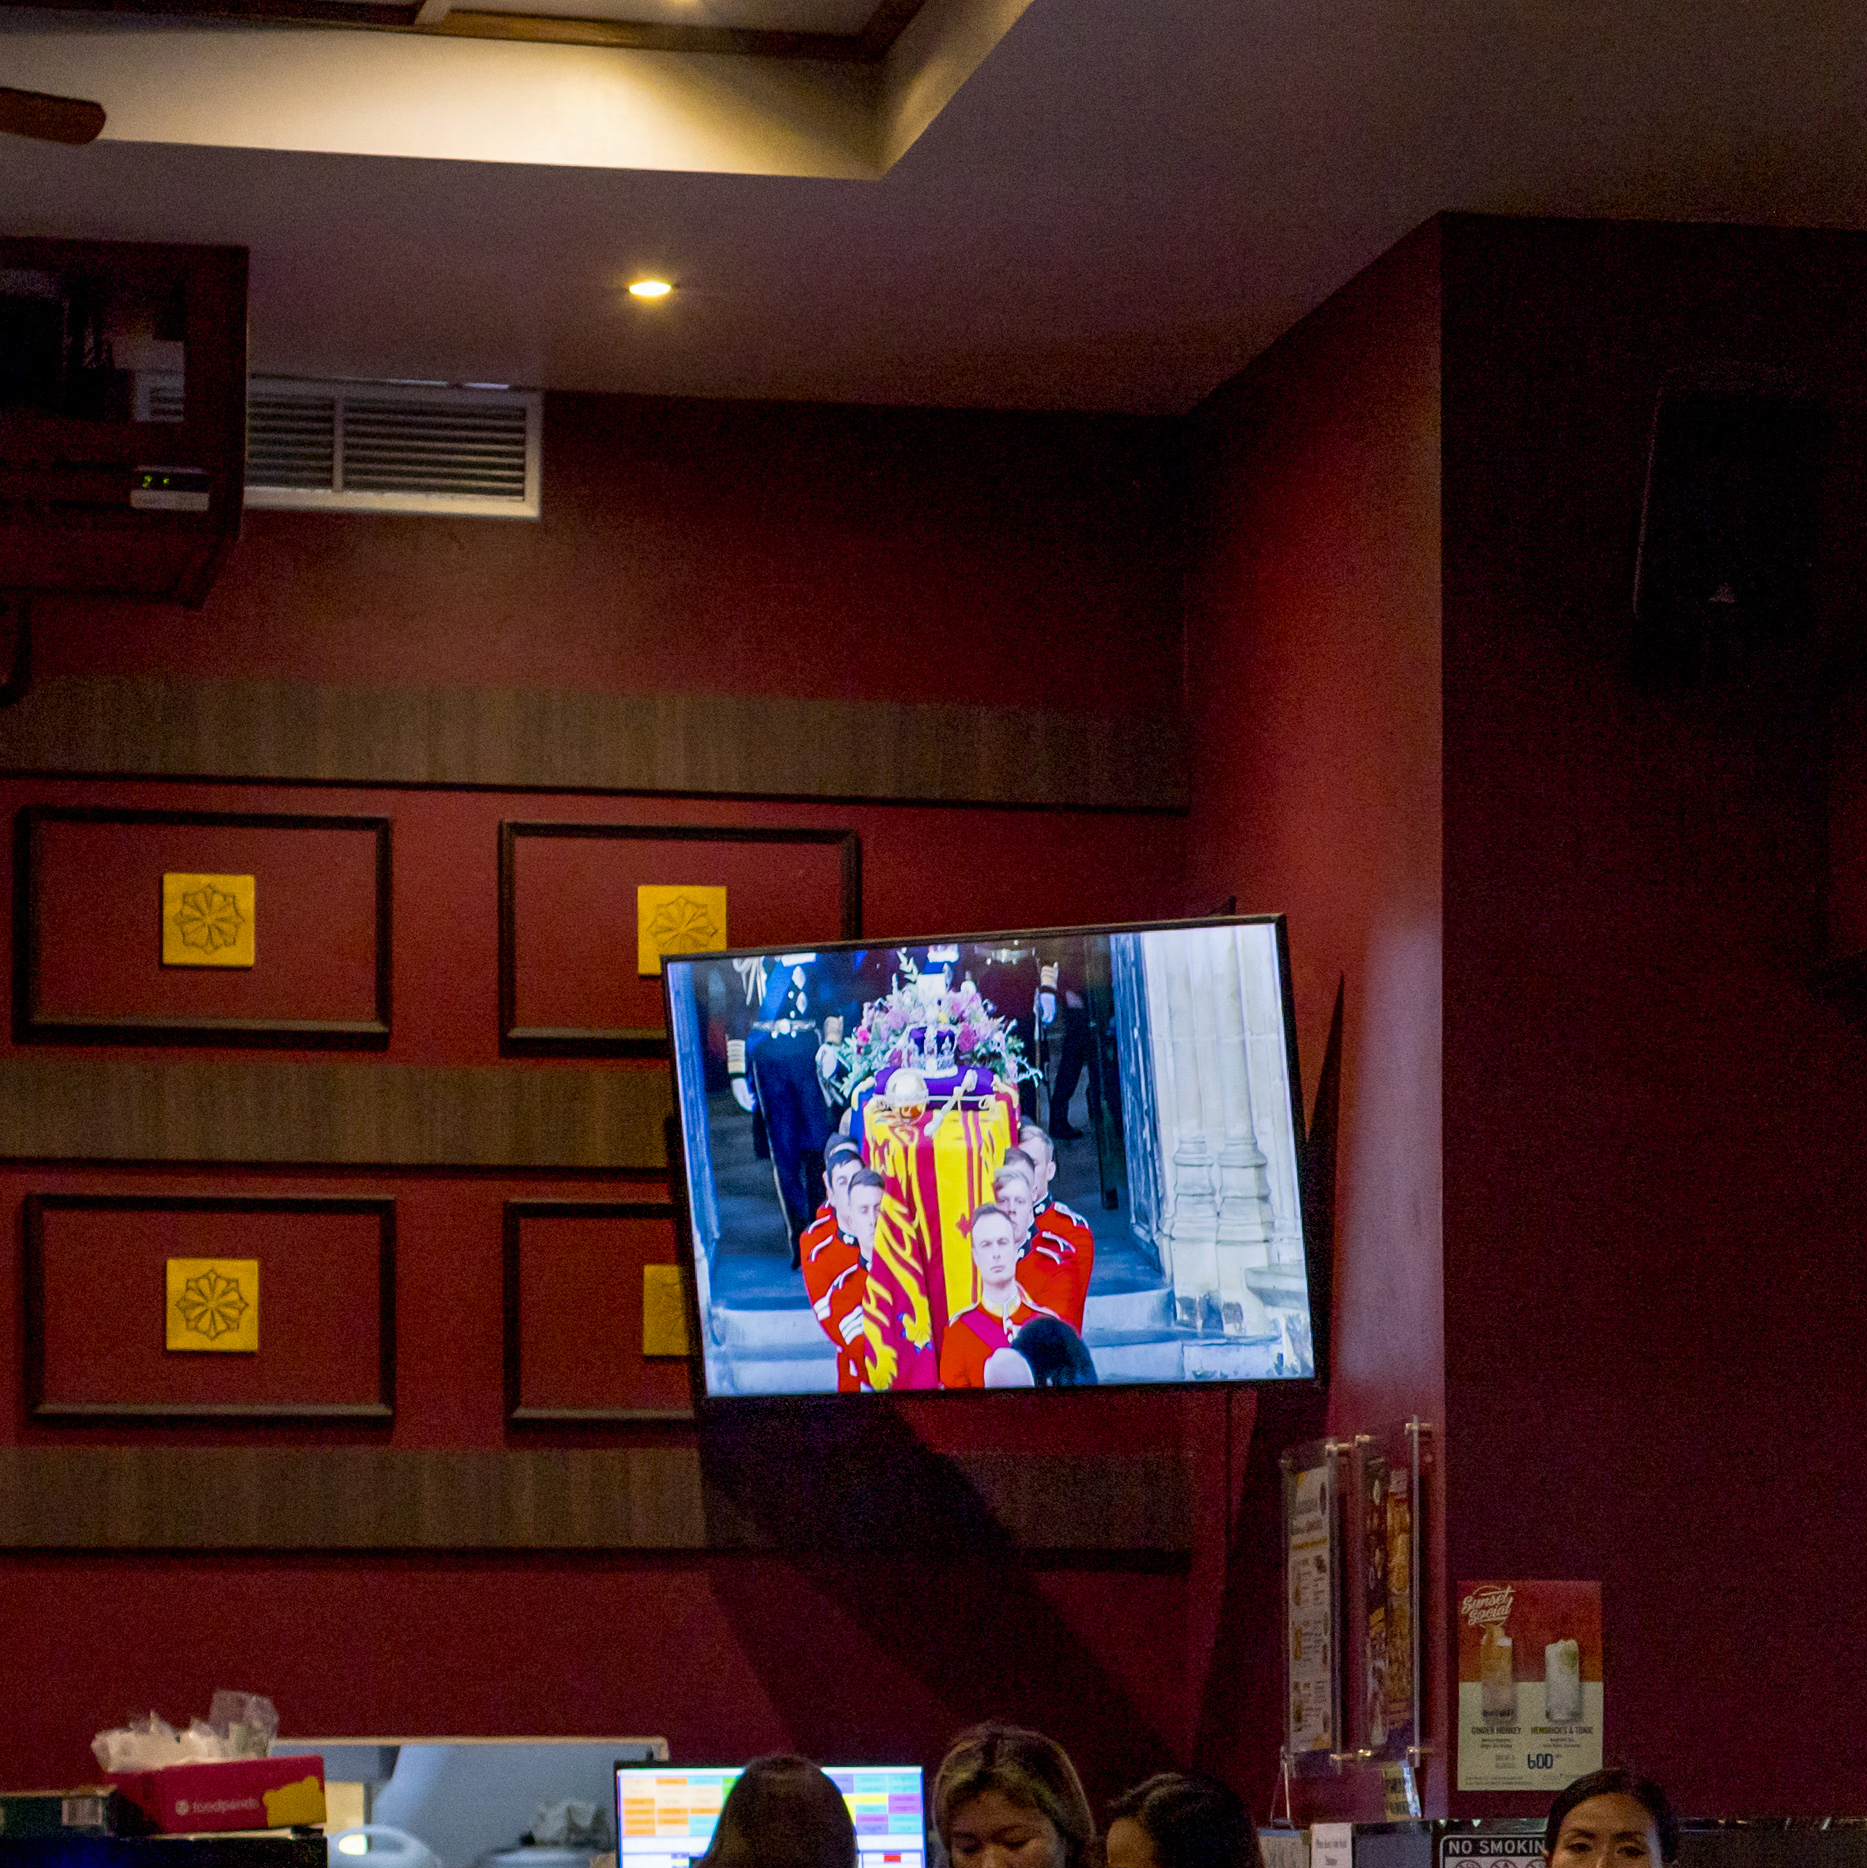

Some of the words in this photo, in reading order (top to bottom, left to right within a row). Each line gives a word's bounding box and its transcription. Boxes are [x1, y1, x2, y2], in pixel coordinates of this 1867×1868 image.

[1461, 1585, 1516, 1614] Sunset
[1467, 1596, 1514, 1626] Social
[1527, 1753, 1554, 1769] 600
[1448, 1840, 1473, 1855] NO
[1479, 1840, 1547, 1855] SMOKIN
